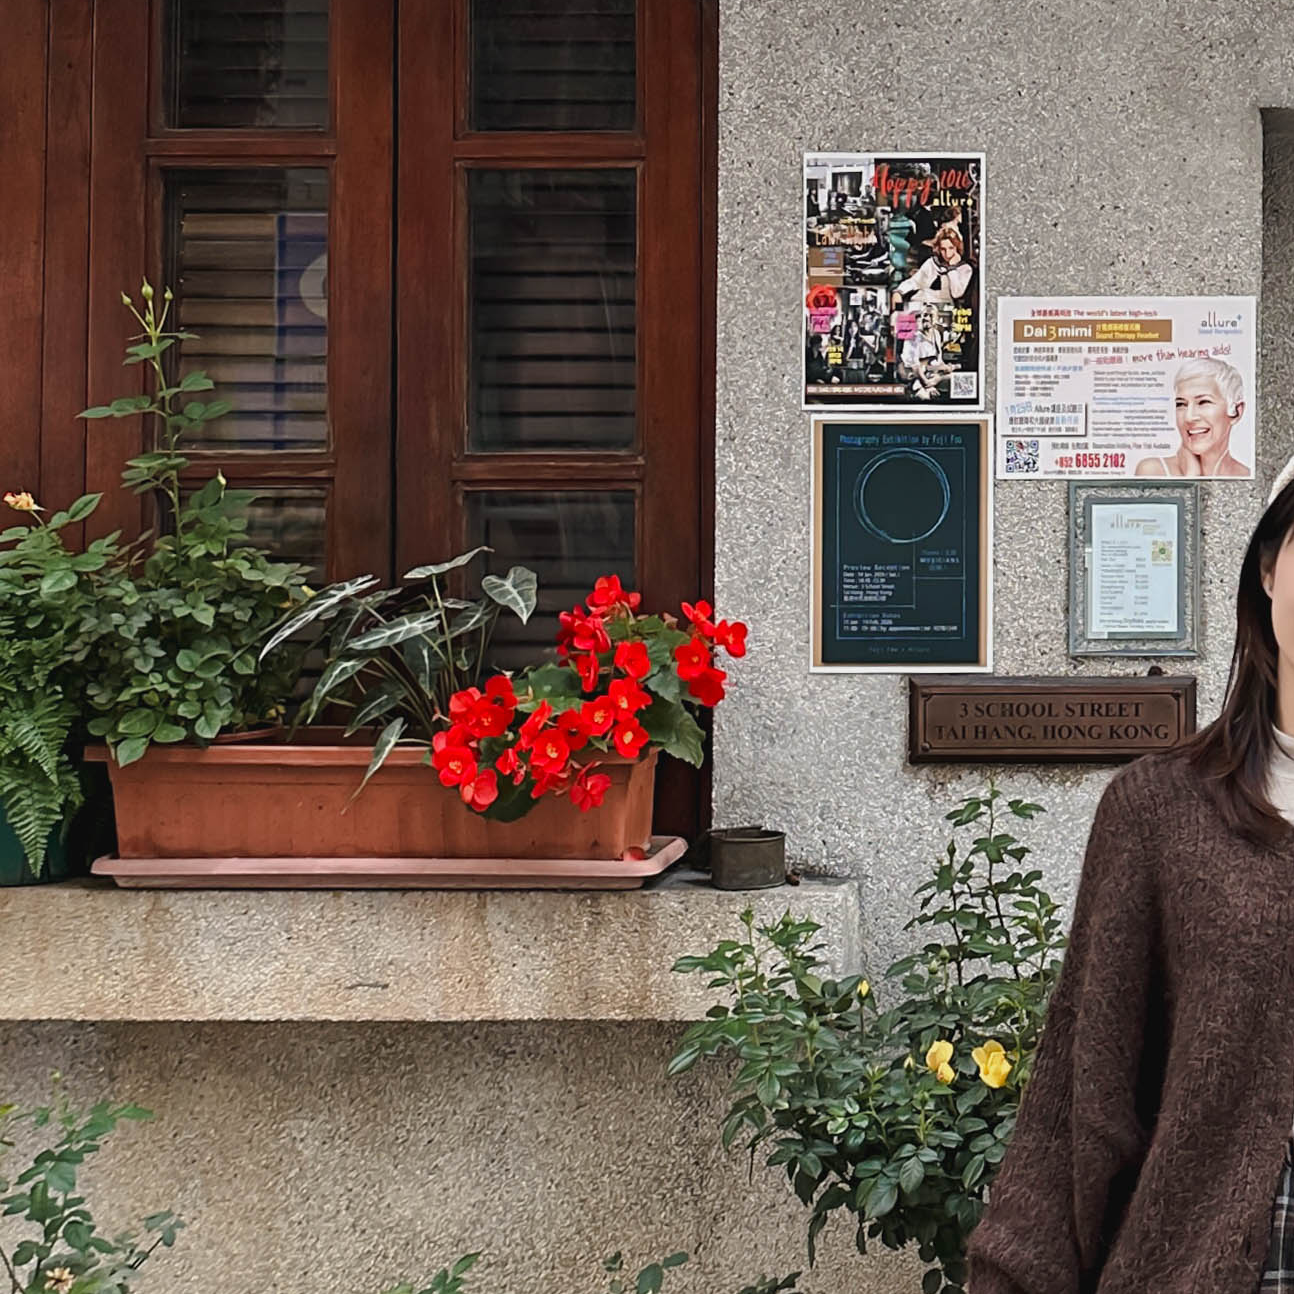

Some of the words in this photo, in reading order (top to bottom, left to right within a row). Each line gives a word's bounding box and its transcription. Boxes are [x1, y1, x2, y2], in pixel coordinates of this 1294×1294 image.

[959, 702, 969, 718] 3
[973, 702, 1060, 718] SCHOOL
[1065, 702, 1144, 718] STREET
[935, 724, 967, 740] TAI
[1042, 724, 1103, 740] HONG
[1107, 724, 1170, 740] KONG
